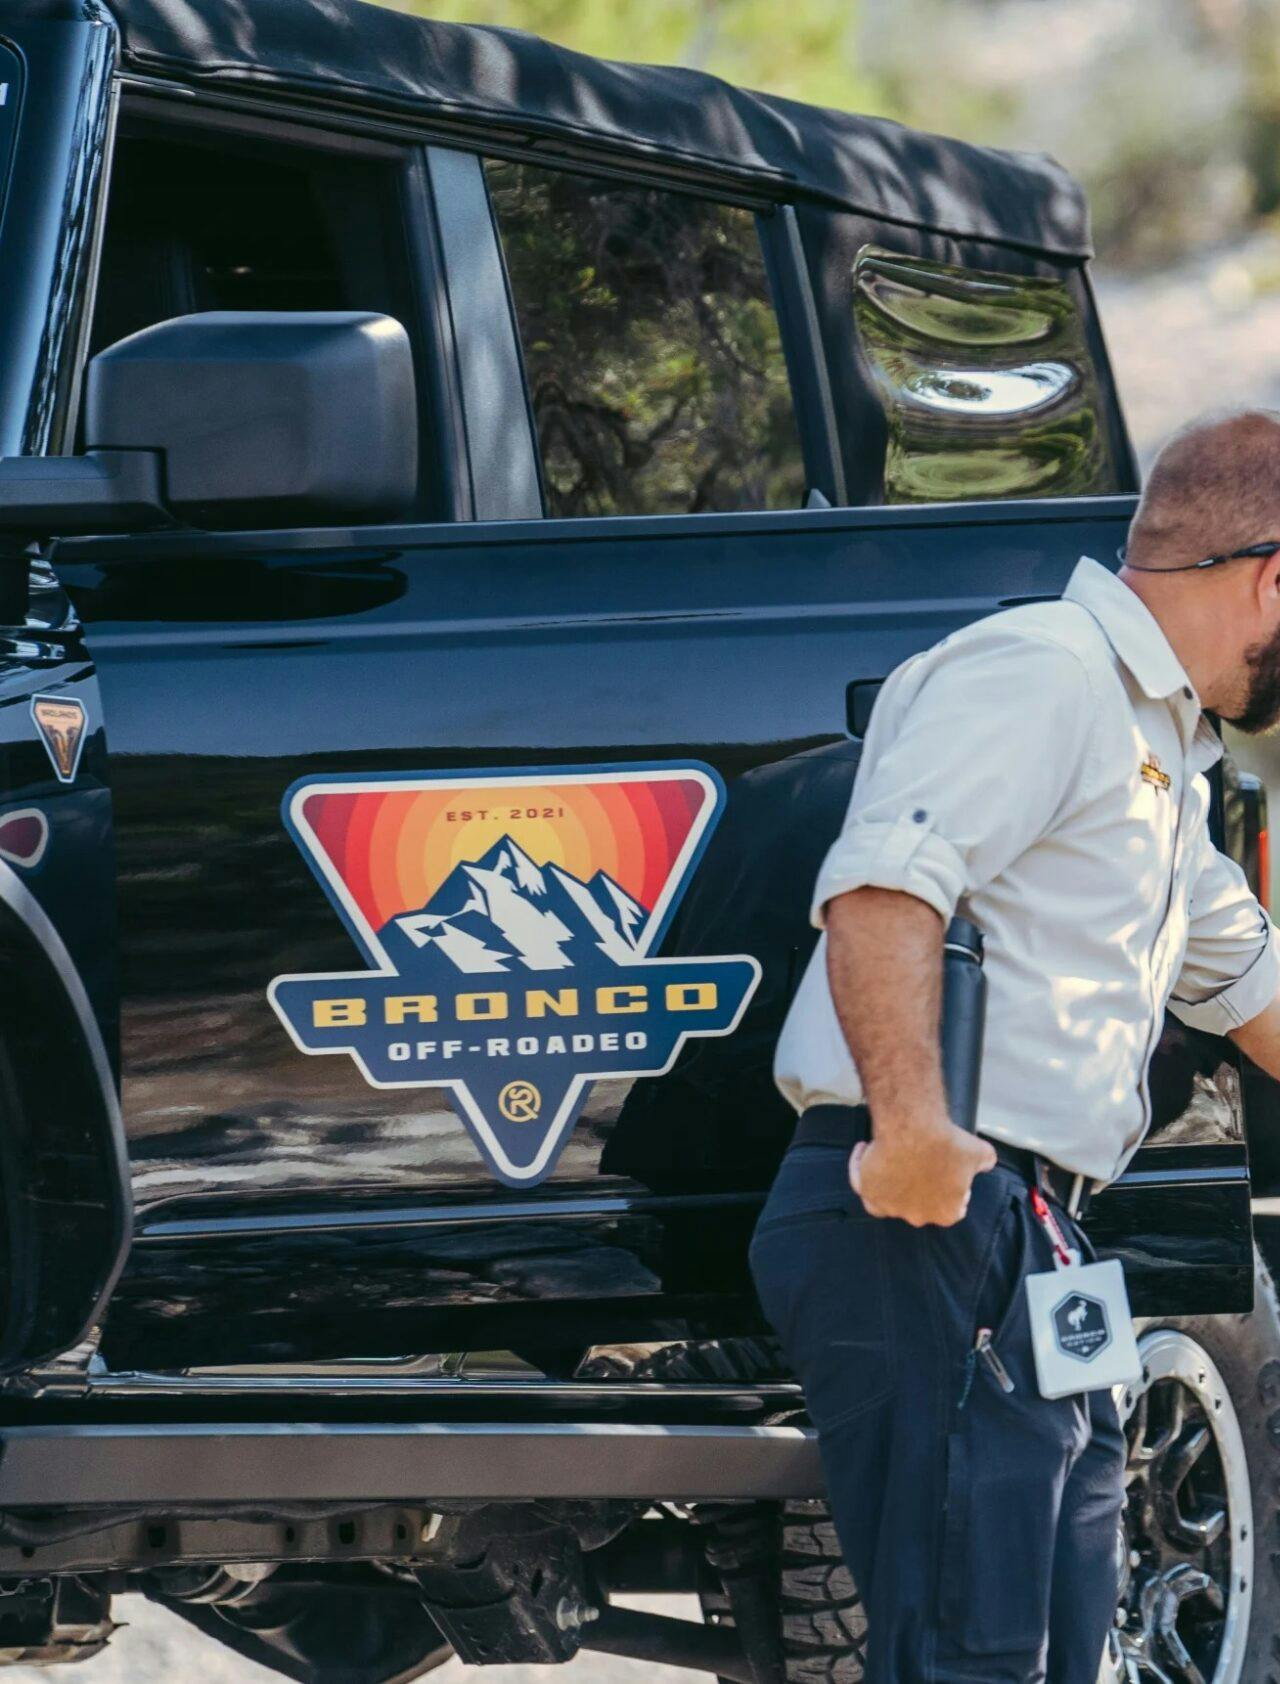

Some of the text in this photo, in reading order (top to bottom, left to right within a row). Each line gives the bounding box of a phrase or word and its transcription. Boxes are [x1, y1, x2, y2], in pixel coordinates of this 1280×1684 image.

[446, 807, 563, 821] EST. 2021
[312, 982, 718, 1028] BRONCO
[387, 1031, 648, 1062] OFF-ROADEO
